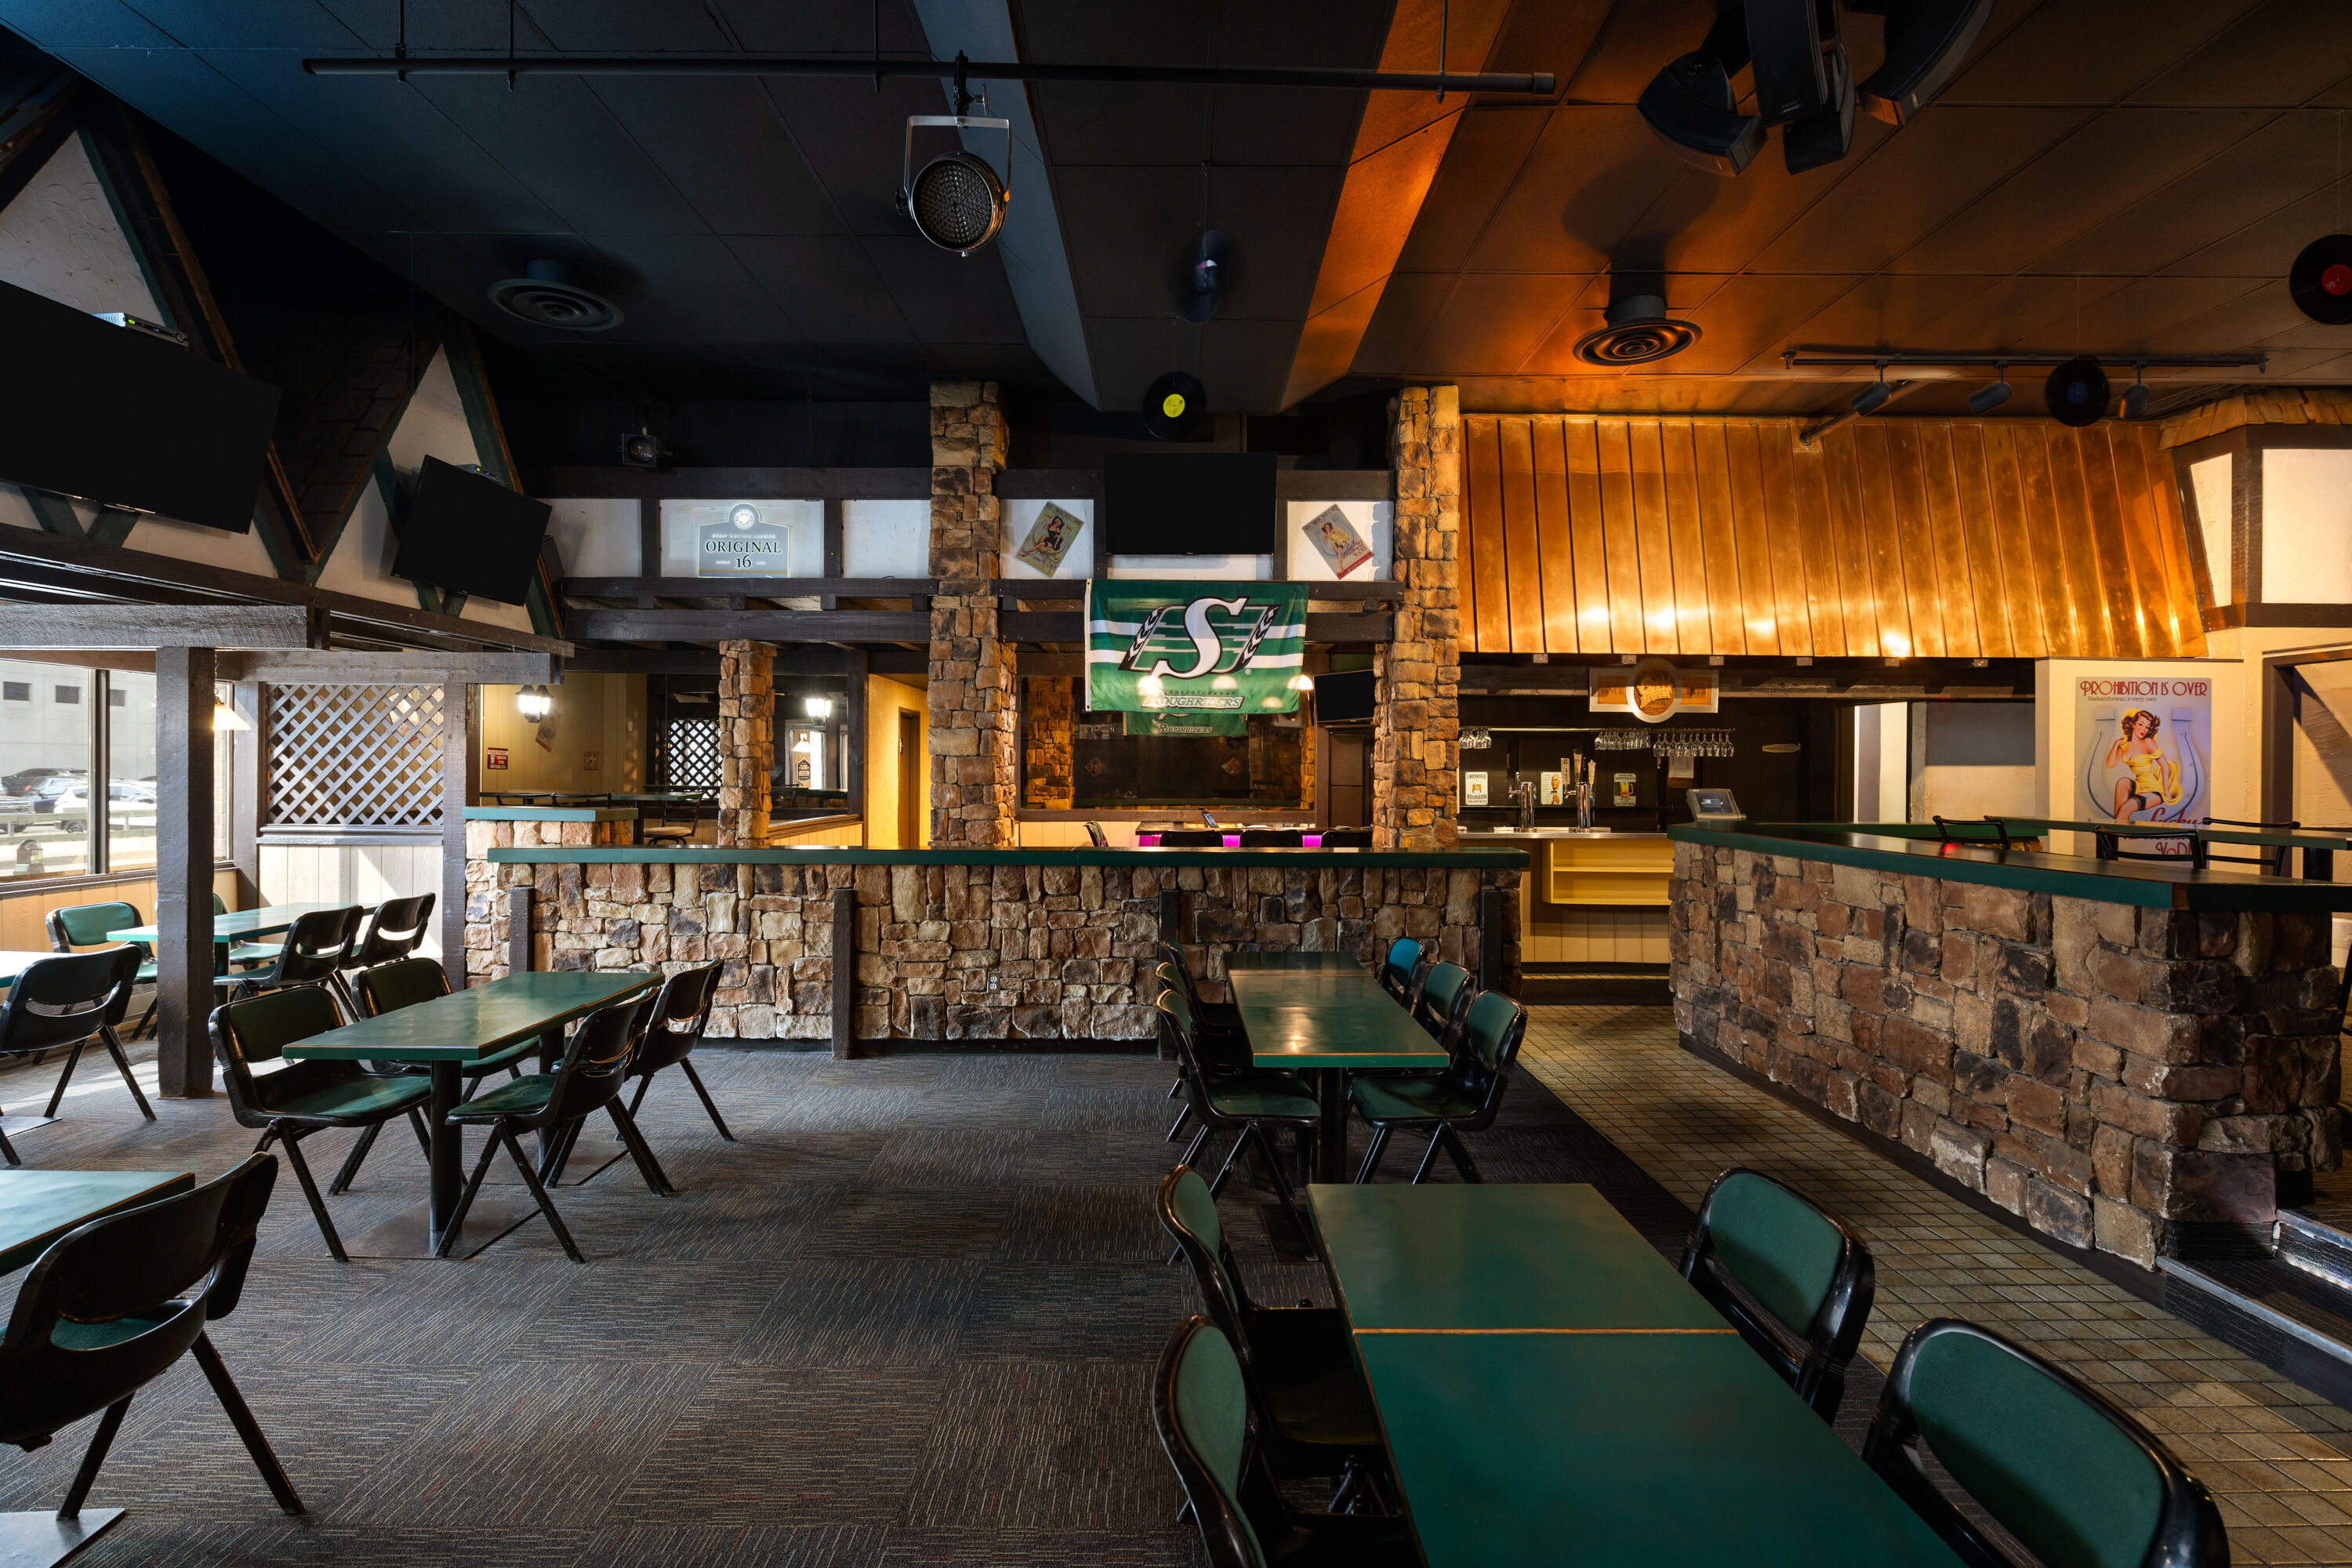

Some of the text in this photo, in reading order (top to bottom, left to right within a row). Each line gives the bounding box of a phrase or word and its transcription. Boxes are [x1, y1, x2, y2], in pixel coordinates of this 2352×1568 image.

[706, 540, 782, 553] ORIGINAL
[735, 554, 752, 568] 16
[2080, 681, 2208, 696] PROHIBITION IS OVER
